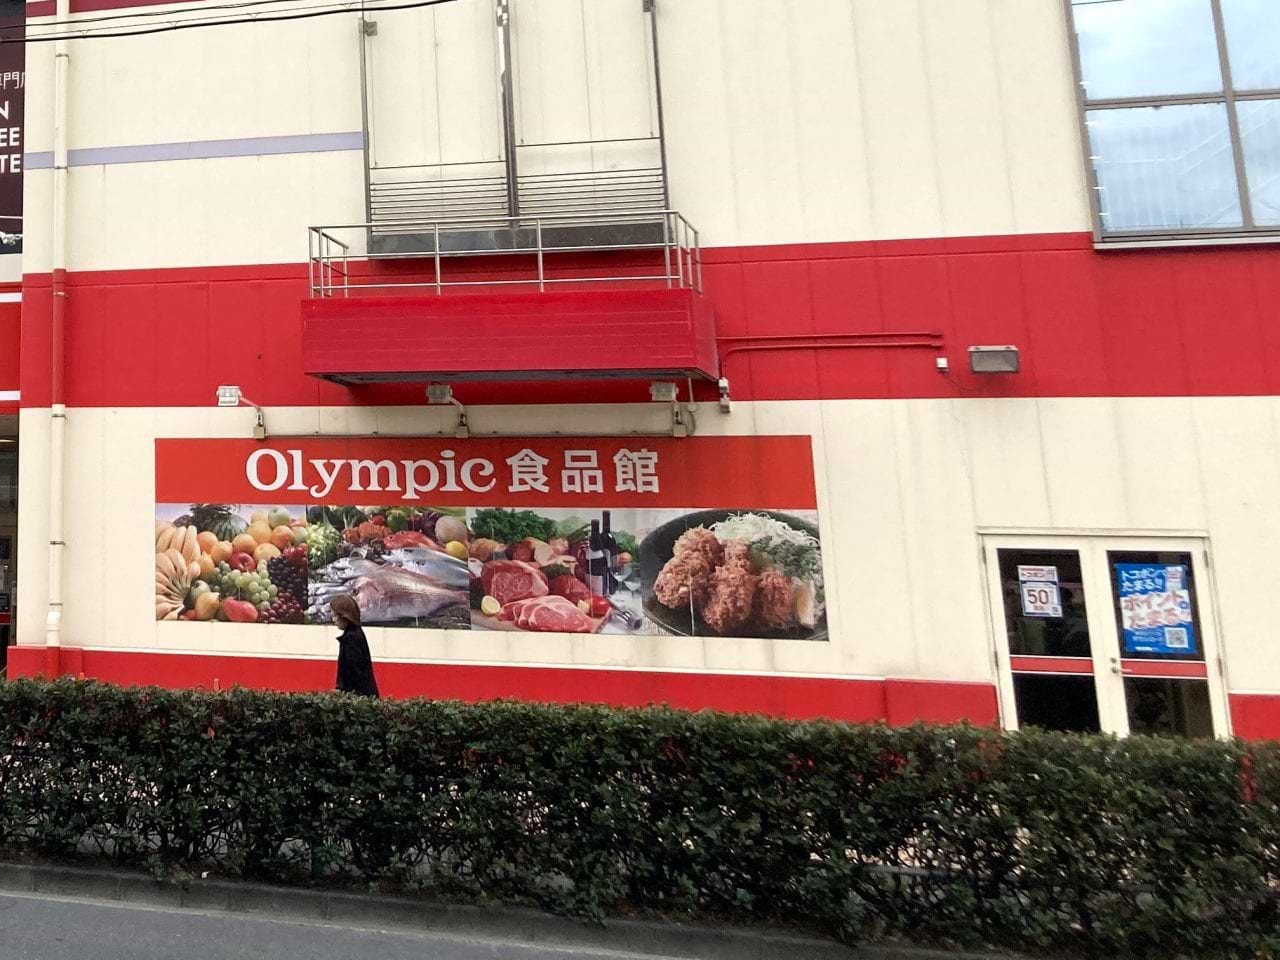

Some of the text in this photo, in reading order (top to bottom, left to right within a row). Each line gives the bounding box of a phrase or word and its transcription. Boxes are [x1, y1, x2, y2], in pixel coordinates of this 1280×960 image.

[245, 448, 660, 500] Olympic 食品館
[1027, 589, 1049, 605] 50
